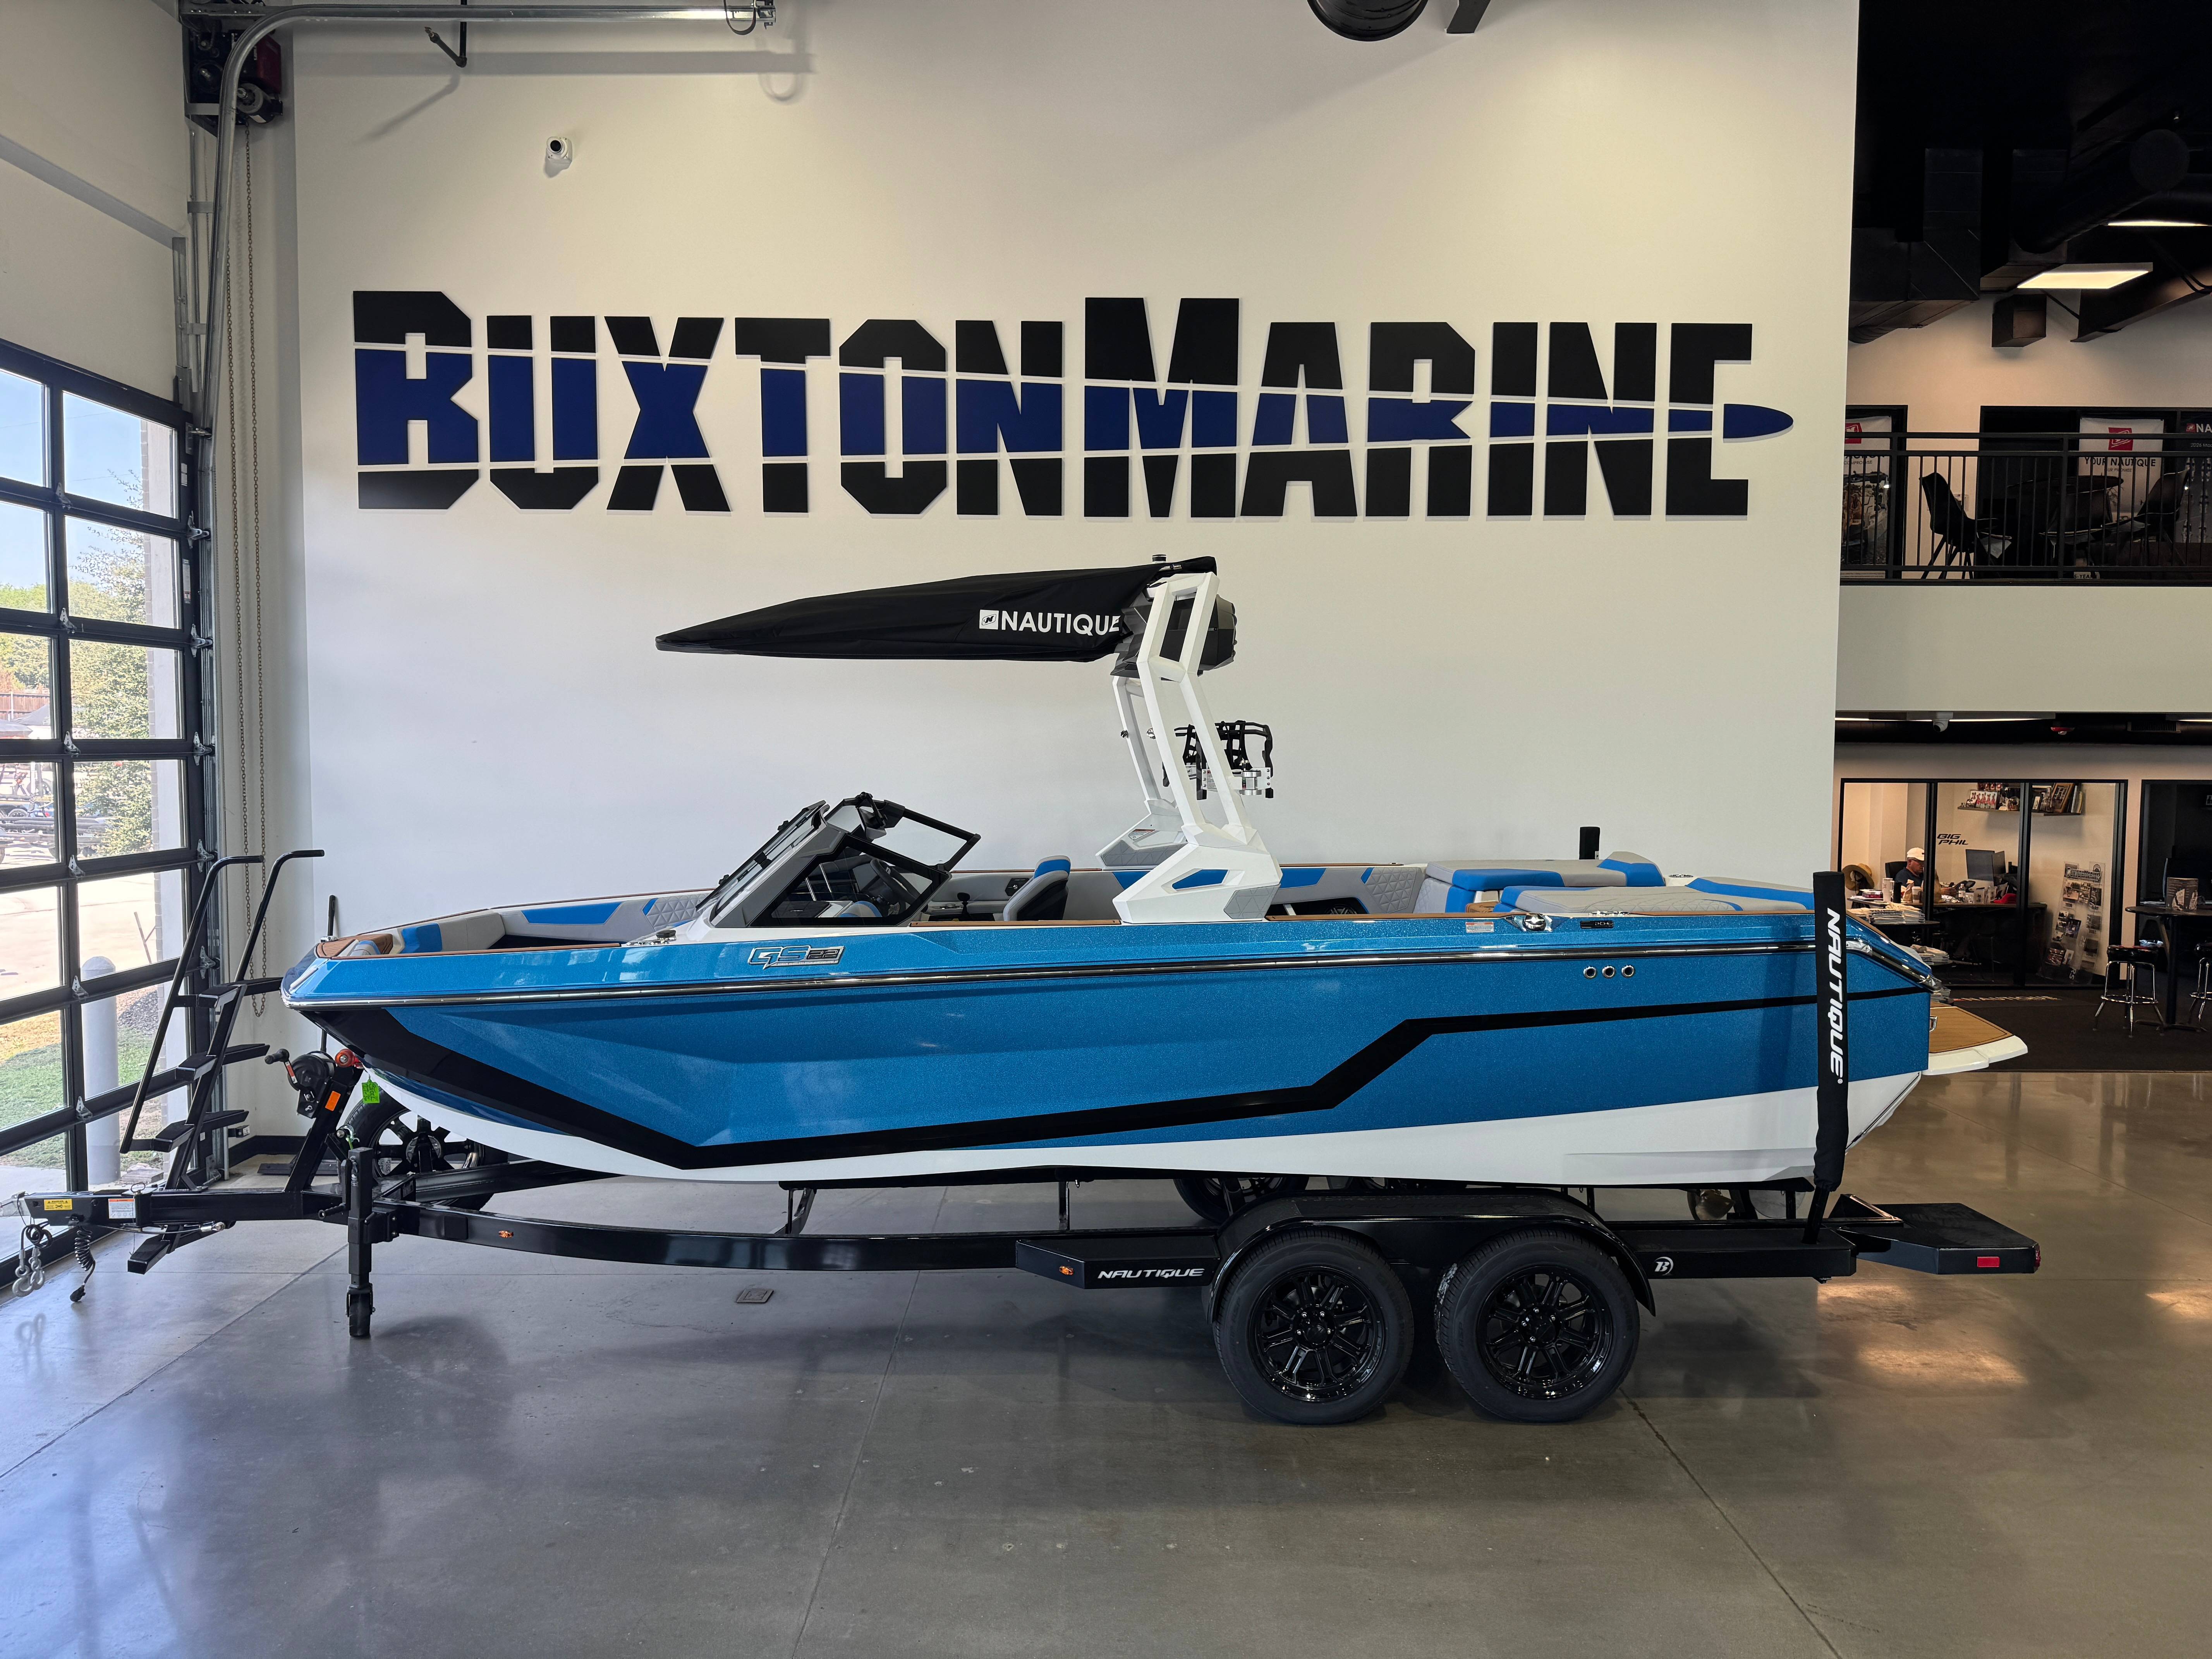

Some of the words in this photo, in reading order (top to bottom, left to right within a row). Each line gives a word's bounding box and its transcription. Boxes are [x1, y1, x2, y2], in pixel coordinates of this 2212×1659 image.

[1001, 610, 1121, 636] NAUTIQUE
[1827, 907, 1843, 1078] NAUTIQUE
[1097, 1268, 1205, 1279] NAUTIQUE
